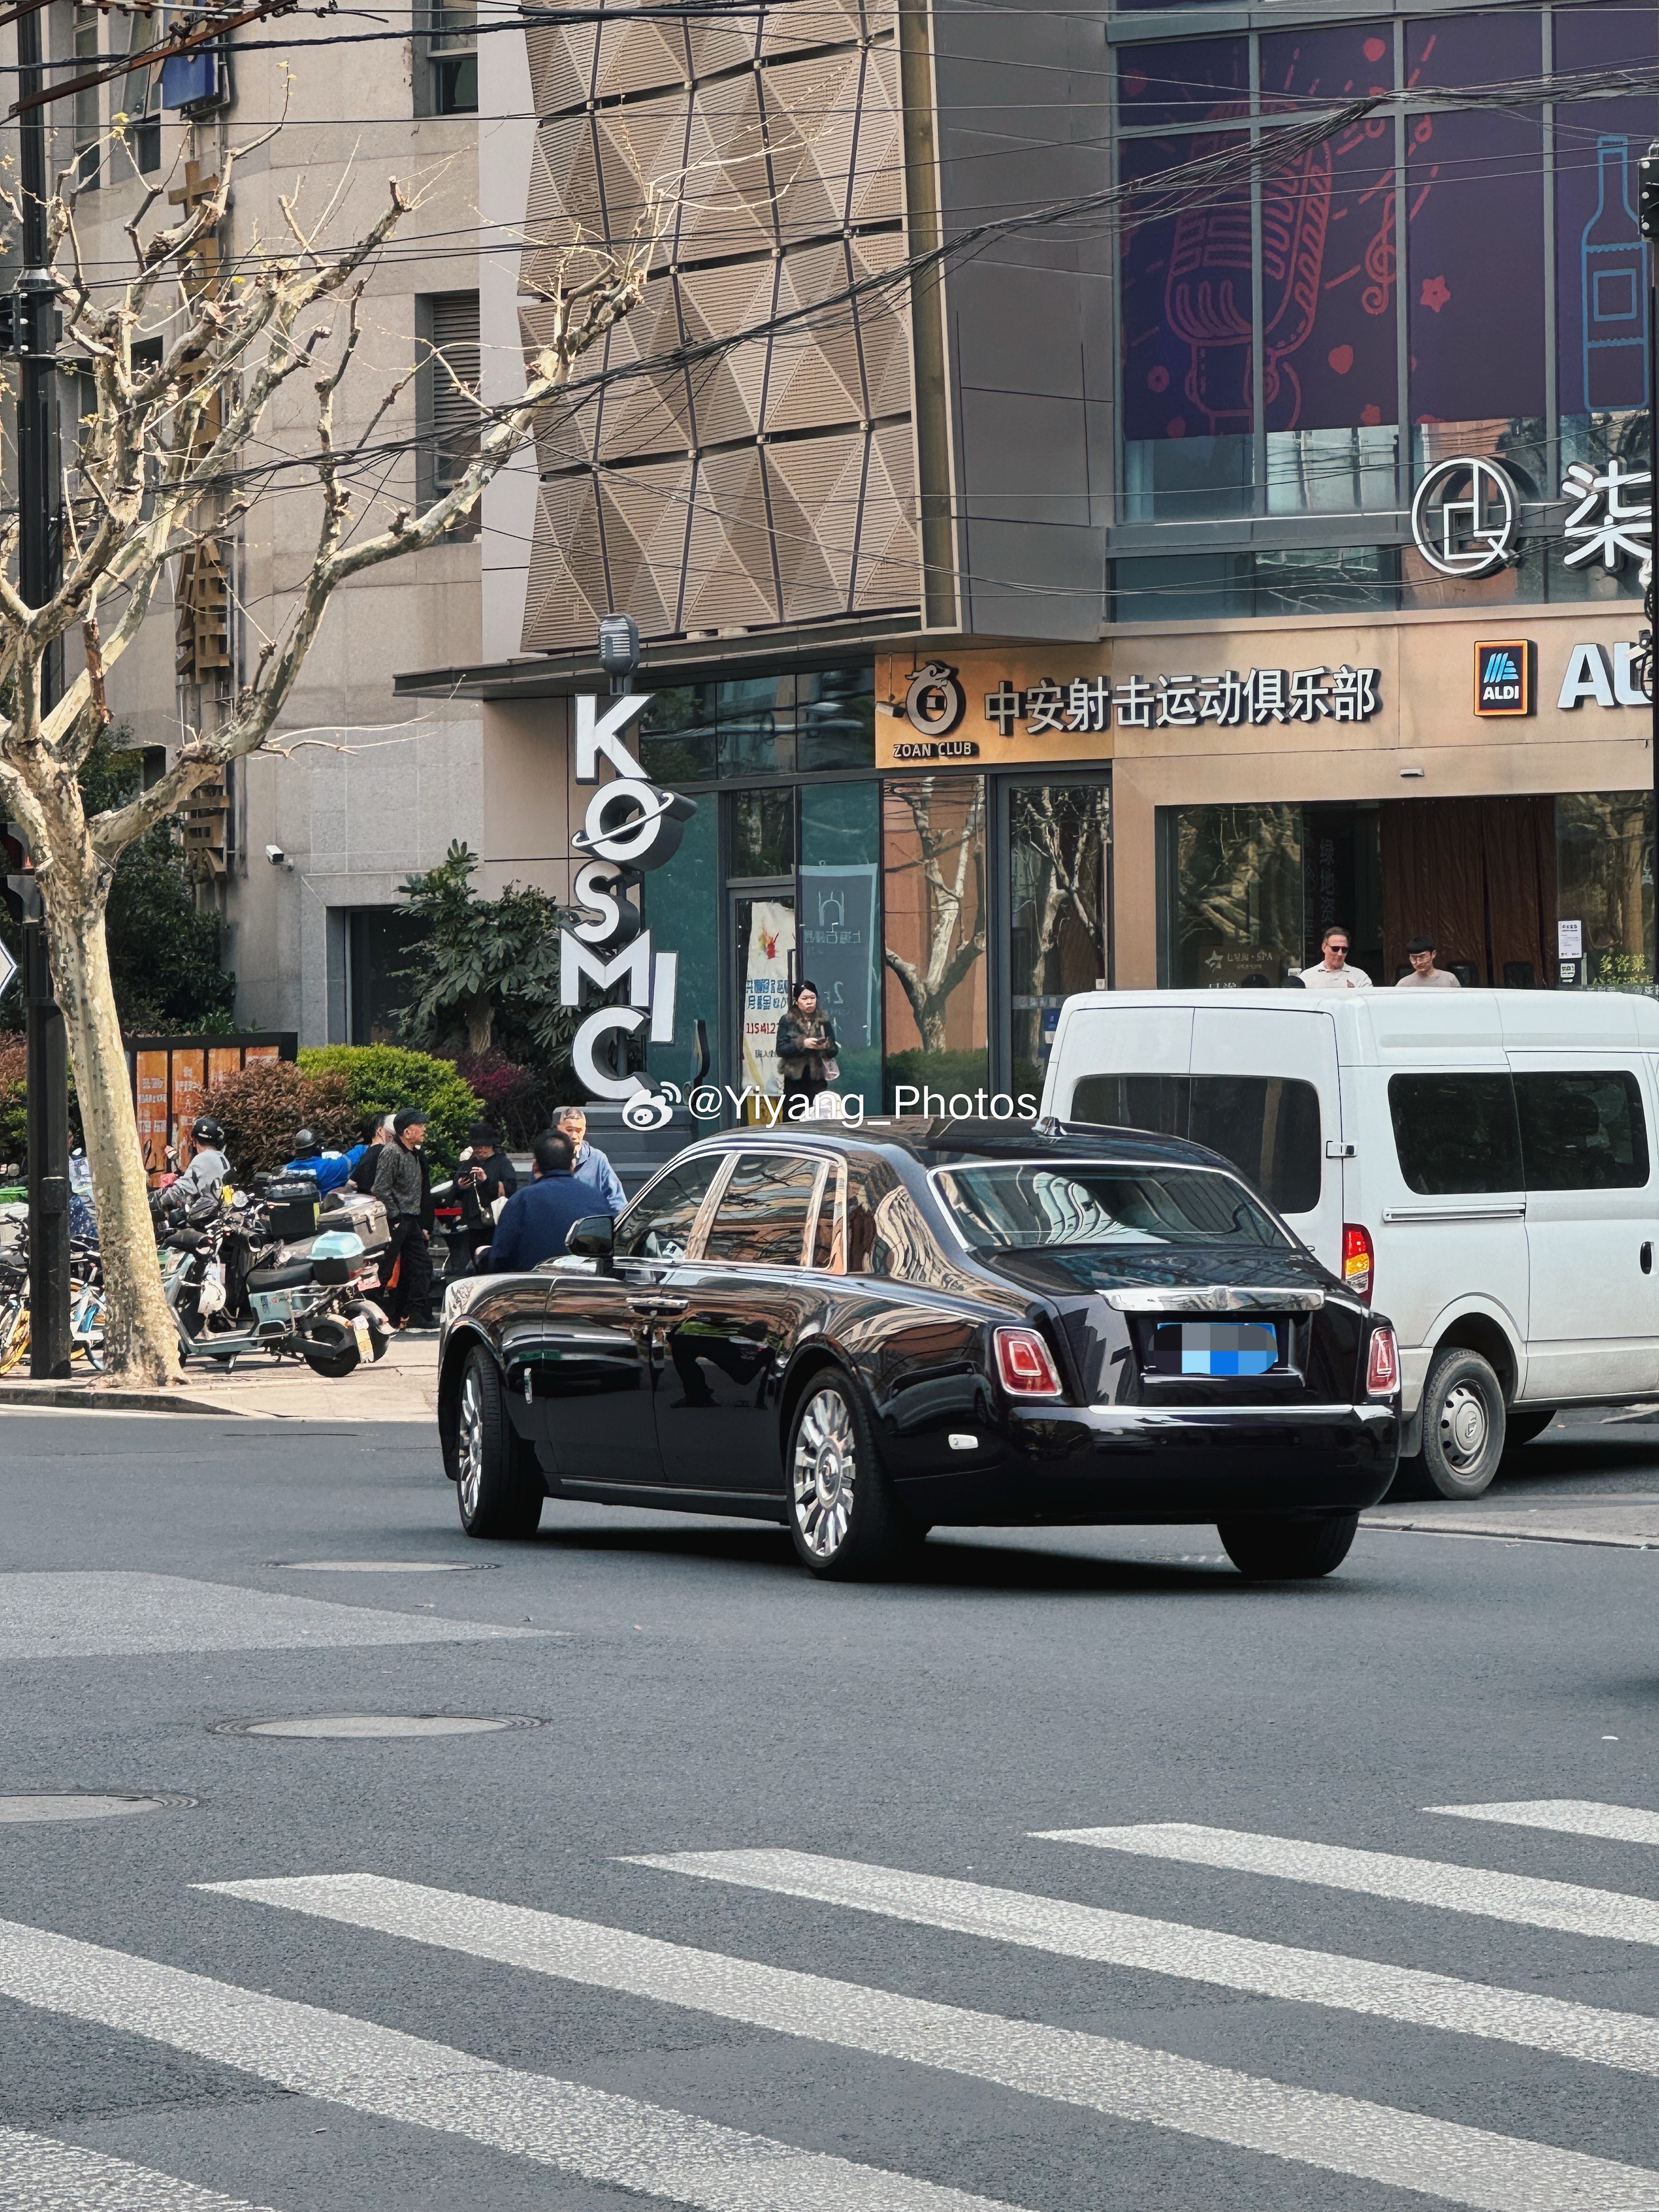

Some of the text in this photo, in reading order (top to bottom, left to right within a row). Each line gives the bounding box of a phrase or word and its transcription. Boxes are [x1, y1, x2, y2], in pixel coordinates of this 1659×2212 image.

[984, 665, 1376, 736] 中安射击运动俱乐部
[1483, 686, 1519, 700] ALDI
[894, 742, 971, 757] ZOAN CLUB
[558, 694, 678, 1100] KOSMIC
